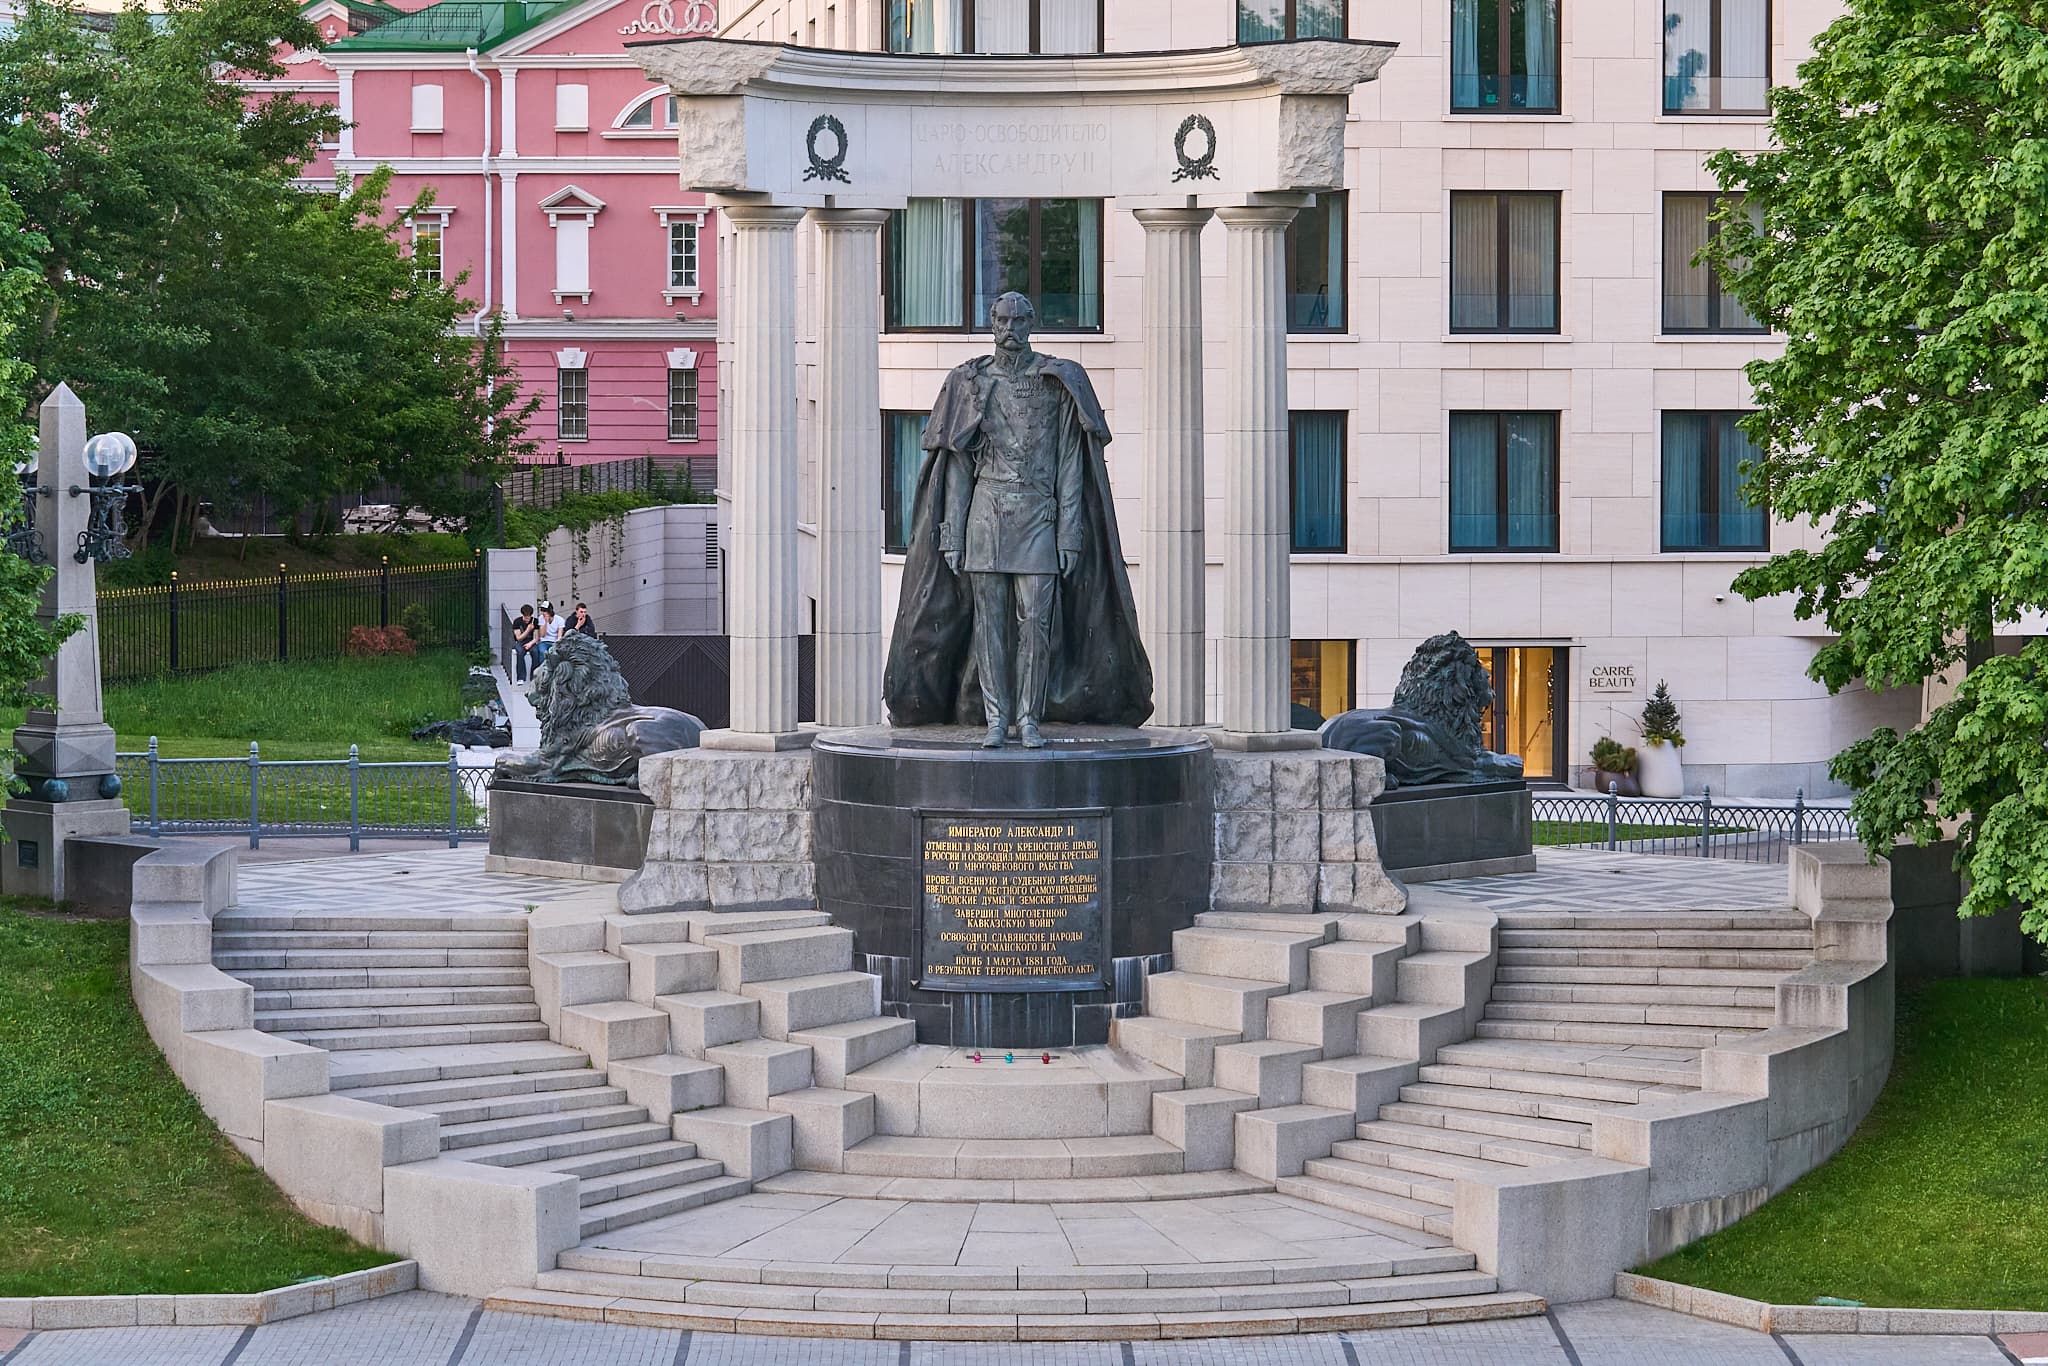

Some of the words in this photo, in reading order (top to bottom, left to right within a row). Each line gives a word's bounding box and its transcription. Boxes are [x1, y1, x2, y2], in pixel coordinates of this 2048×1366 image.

[935, 152, 1077, 175] АЛЕКСАНДРУ
[1083, 152, 1095, 173] II
[1589, 677, 1637, 688] BEAUTY
[949, 826, 1001, 837] ИМПЕРАТОР
[1007, 827, 1063, 837] АЛЕКСАНДР
[1067, 826, 1074, 836] II
[926, 841, 962, 851] ОТМЕНИЛ
[966, 843, 970, 851] В
[974, 842, 990, 851] 1861
[994, 843, 1013, 852] ГОДУ
[1017, 842, 1069, 851] КРЕПОСТНОЕ
[1073, 841, 1096, 850] ПРАВО
[925, 852, 929, 860] В
[932, 852, 959, 861] РОССИИ
[962, 853, 966, 861] И
[968, 853, 1012, 862] ОСВОБОДИЛ
[1015, 852, 1058, 861] МИЛЛИОНЫ
[1062, 850, 1098, 860] КРЕСТЬЯН
[949, 862, 959, 870] ОТ
[964, 862, 1034, 871] МНОГОВЕКОВОГО
[1039, 862, 1073, 870] РАБСТВА
[926, 875, 954, 884] ПРОВЕЛ
[959, 876, 997, 885] ВОЕННУЮ
[1003, 877, 1007, 885] И
[1013, 876, 1055, 885] СУДЕБНУЮ
[1060, 875, 1096, 883] РЕФОРМЫ
[926, 885, 944, 894] ВВЕЛ
[947, 886, 982, 895] СИСТЕМУ
[986, 886, 1027, 895] МЕСТНОГО
[1030, 884, 1097, 895] САМОУПРАВЛЕНИЯ
[934, 895, 977, 905] ГОРОДСКИЕ
[982, 896, 1005, 906] ДУМЫ
[1010, 896, 1014, 904] И
[1019, 895, 1055, 904] ЗЕМСКИЕ
[1059, 895, 1089, 903] УПРАВЫ
[955, 909, 999, 918] ЗАВЕРШИЛ
[1004, 909, 1067, 918] МНОГОЛЕТНЮЮ
[967, 919, 1025, 928] КАВКАЗСКУЮ
[1030, 919, 1056, 928] ВОЙНУ
[941, 932, 987, 942] ОСВОБОДИЛ
[992, 933, 1046, 941] СЛАВЯНСКИЕ
[1050, 932, 1082, 941] НАРОДЫ
[966, 942, 977, 951] ОТ
[981, 943, 1037, 951] ОСМАНСКОГО
[1041, 942, 1056, 951] ИГА
[956, 956, 982, 965] ПОГИБ
[987, 957, 990, 965] 1
[993, 957, 1021, 965] МАРТА
[1026, 956, 1042, 965] 1881
[1047, 956, 1067, 965] ГОДА
[928, 965, 932, 973] В
[935, 966, 981, 975] РЕЗУЛЬТАТЕ
[986, 966, 1073, 976] ТЕРРОРИСТИЧЕСКОГО
[1076, 964, 1095, 974] АКТА
